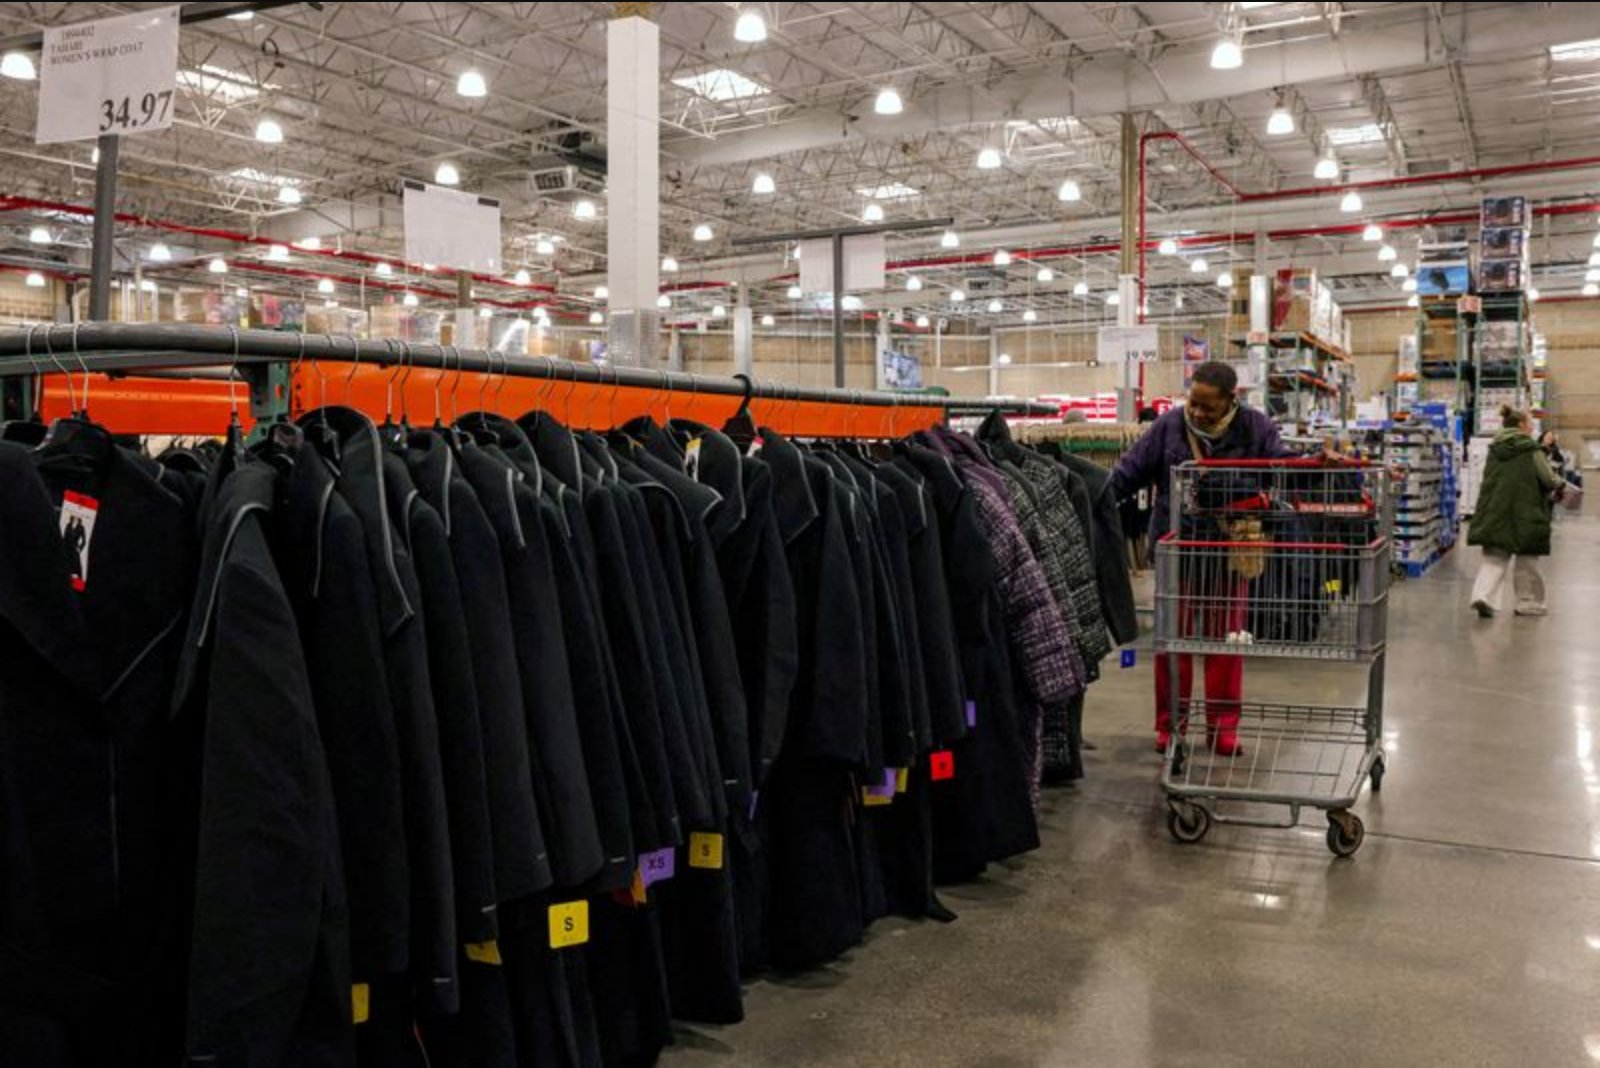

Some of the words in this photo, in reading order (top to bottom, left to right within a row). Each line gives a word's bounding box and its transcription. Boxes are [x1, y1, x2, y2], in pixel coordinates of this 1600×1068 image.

[50, 50, 91, 65] WOMEN'S
[92, 46, 118, 58] WRAP
[119, 41, 144, 56] COAT
[99, 89, 173, 132] 34.97
[702, 844, 710, 857] S
[648, 856, 665, 870] XS
[564, 916, 574, 932] S
